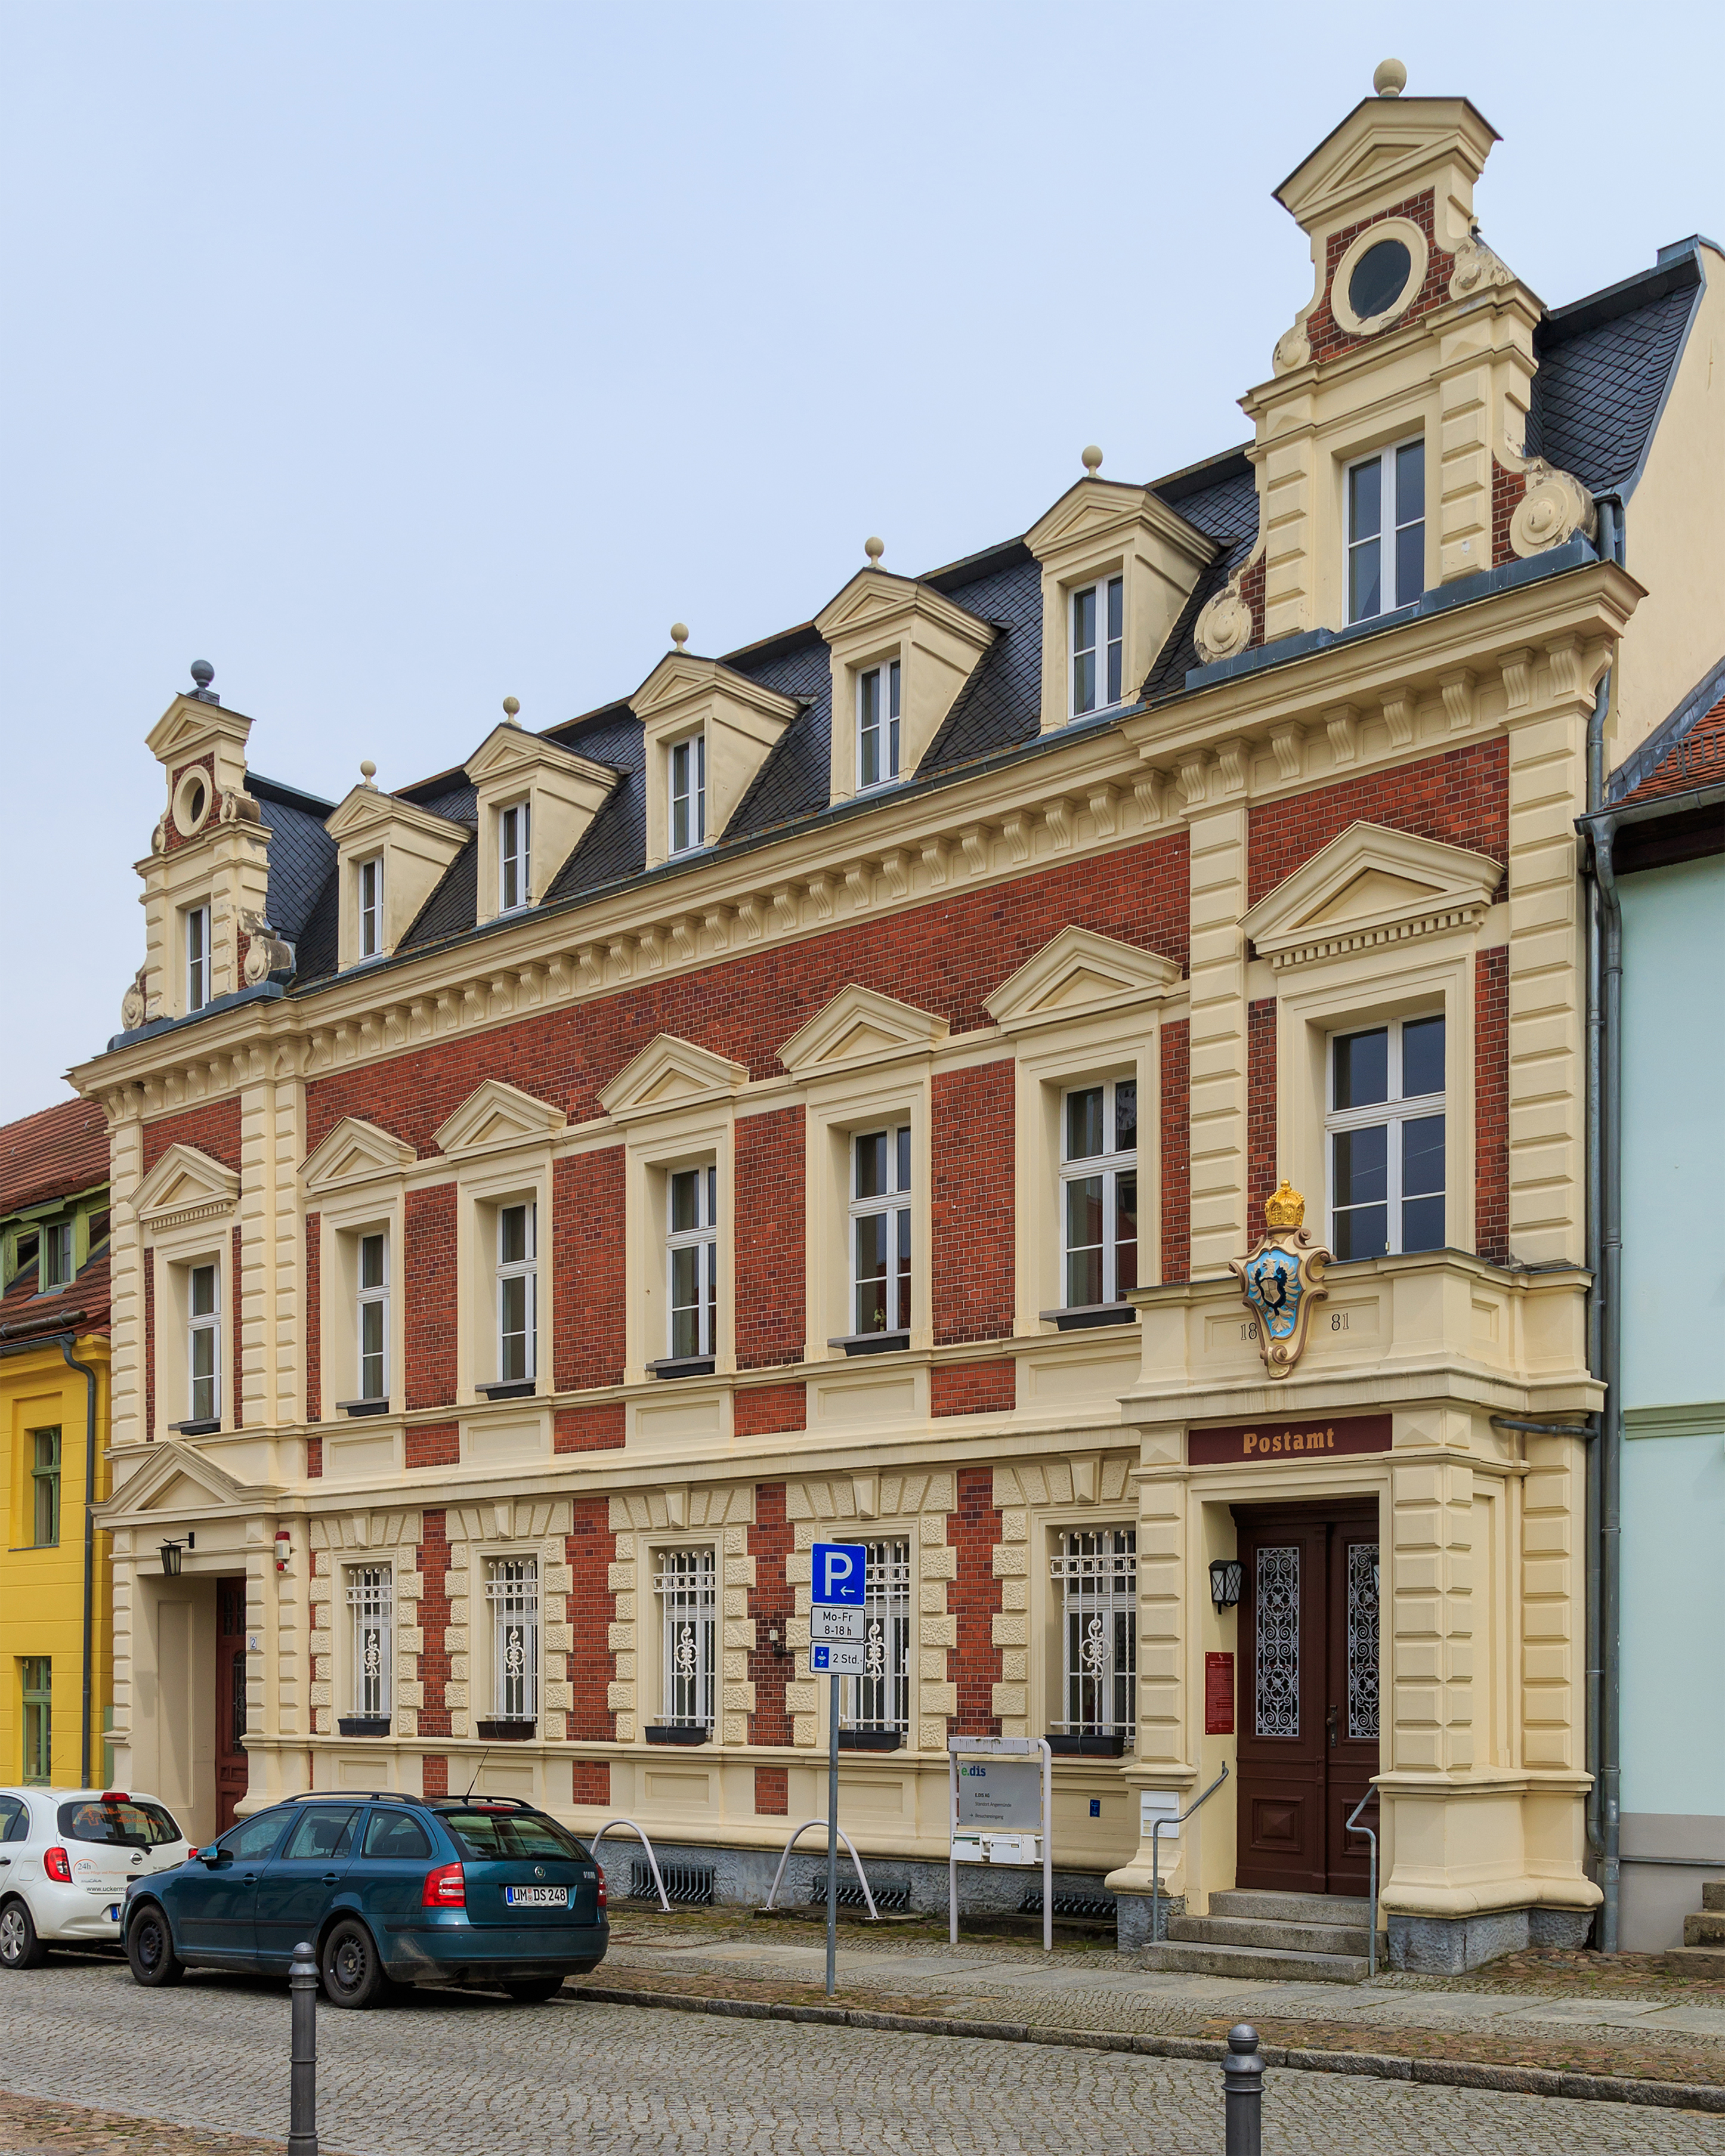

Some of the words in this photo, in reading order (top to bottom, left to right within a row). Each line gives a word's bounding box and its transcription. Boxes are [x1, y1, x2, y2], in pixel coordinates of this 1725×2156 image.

[1241, 1322, 1257, 1341] 18
[1331, 1313, 1349, 1331] 81
[1243, 1428, 1335, 1454] Postamt
[825, 1552, 853, 1596] P
[823, 1611, 854, 1622] Mo-Fr
[824, 1625, 845, 1635] 8-18
[846, 1626, 852, 1636] h
[251, 1638, 256, 1648] 2
[833, 1653, 839, 1663] 2
[841, 1654, 860, 1665] Std.
[961, 1765, 987, 1777] e.dis
[513, 1888, 527, 1901] UM
[533, 1889, 546, 1901] DS
[548, 1889, 566, 1901] 248
